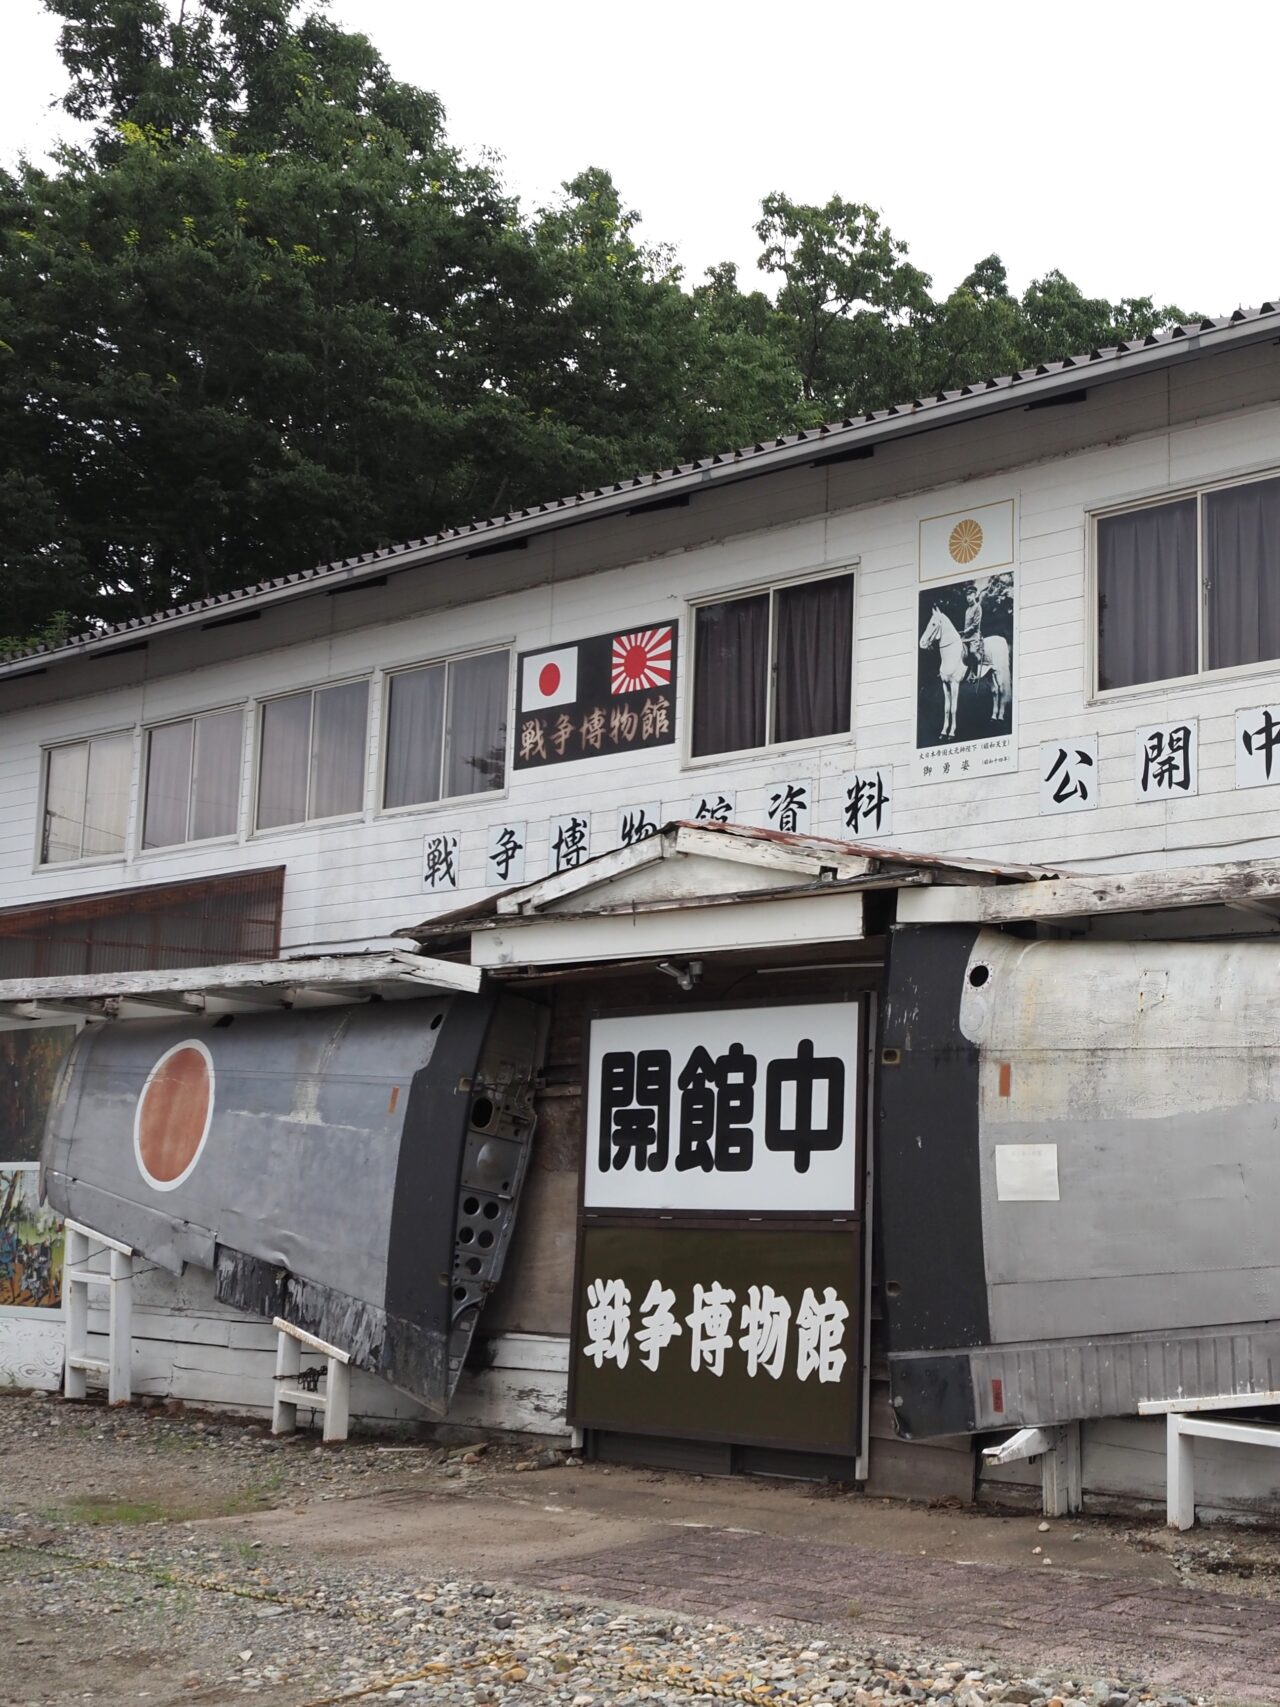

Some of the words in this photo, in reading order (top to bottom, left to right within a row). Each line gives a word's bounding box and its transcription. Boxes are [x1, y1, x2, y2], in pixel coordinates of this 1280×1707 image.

[519, 695, 671, 761] 戦争博物館
[598, 1038, 846, 1174] 開館中
[582, 1277, 850, 1383] 戦争博物館
